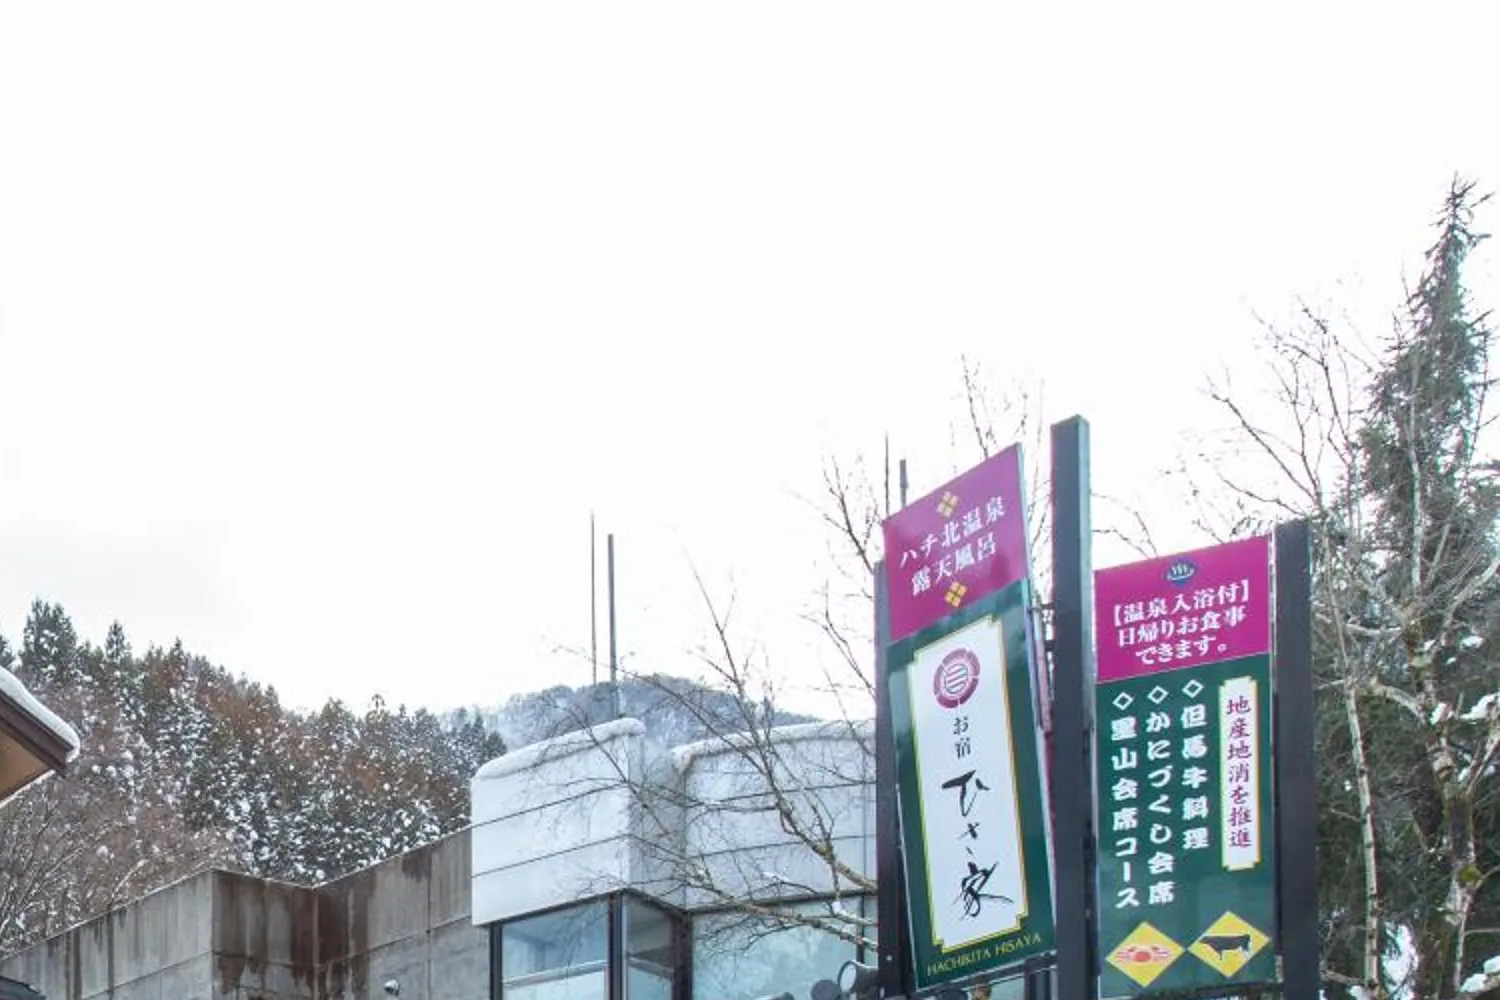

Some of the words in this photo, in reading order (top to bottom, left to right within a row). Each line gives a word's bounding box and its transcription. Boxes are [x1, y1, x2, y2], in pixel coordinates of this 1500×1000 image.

[900, 496, 1005, 568] ハチ北温泉
[911, 532, 996, 597] 露天風呂
[1118, 605, 1247, 647] 日帰りお食事
[1135, 636, 1228, 665] できます。
[1180, 704, 1209, 850] 但馬牛料理
[1226, 695, 1252, 848] 地産地消を推進
[1145, 711, 1175, 906] かにづくし会席
[927, 948, 991, 977] HACHIKITA
[995, 933, 1041, 956] HISAYA
